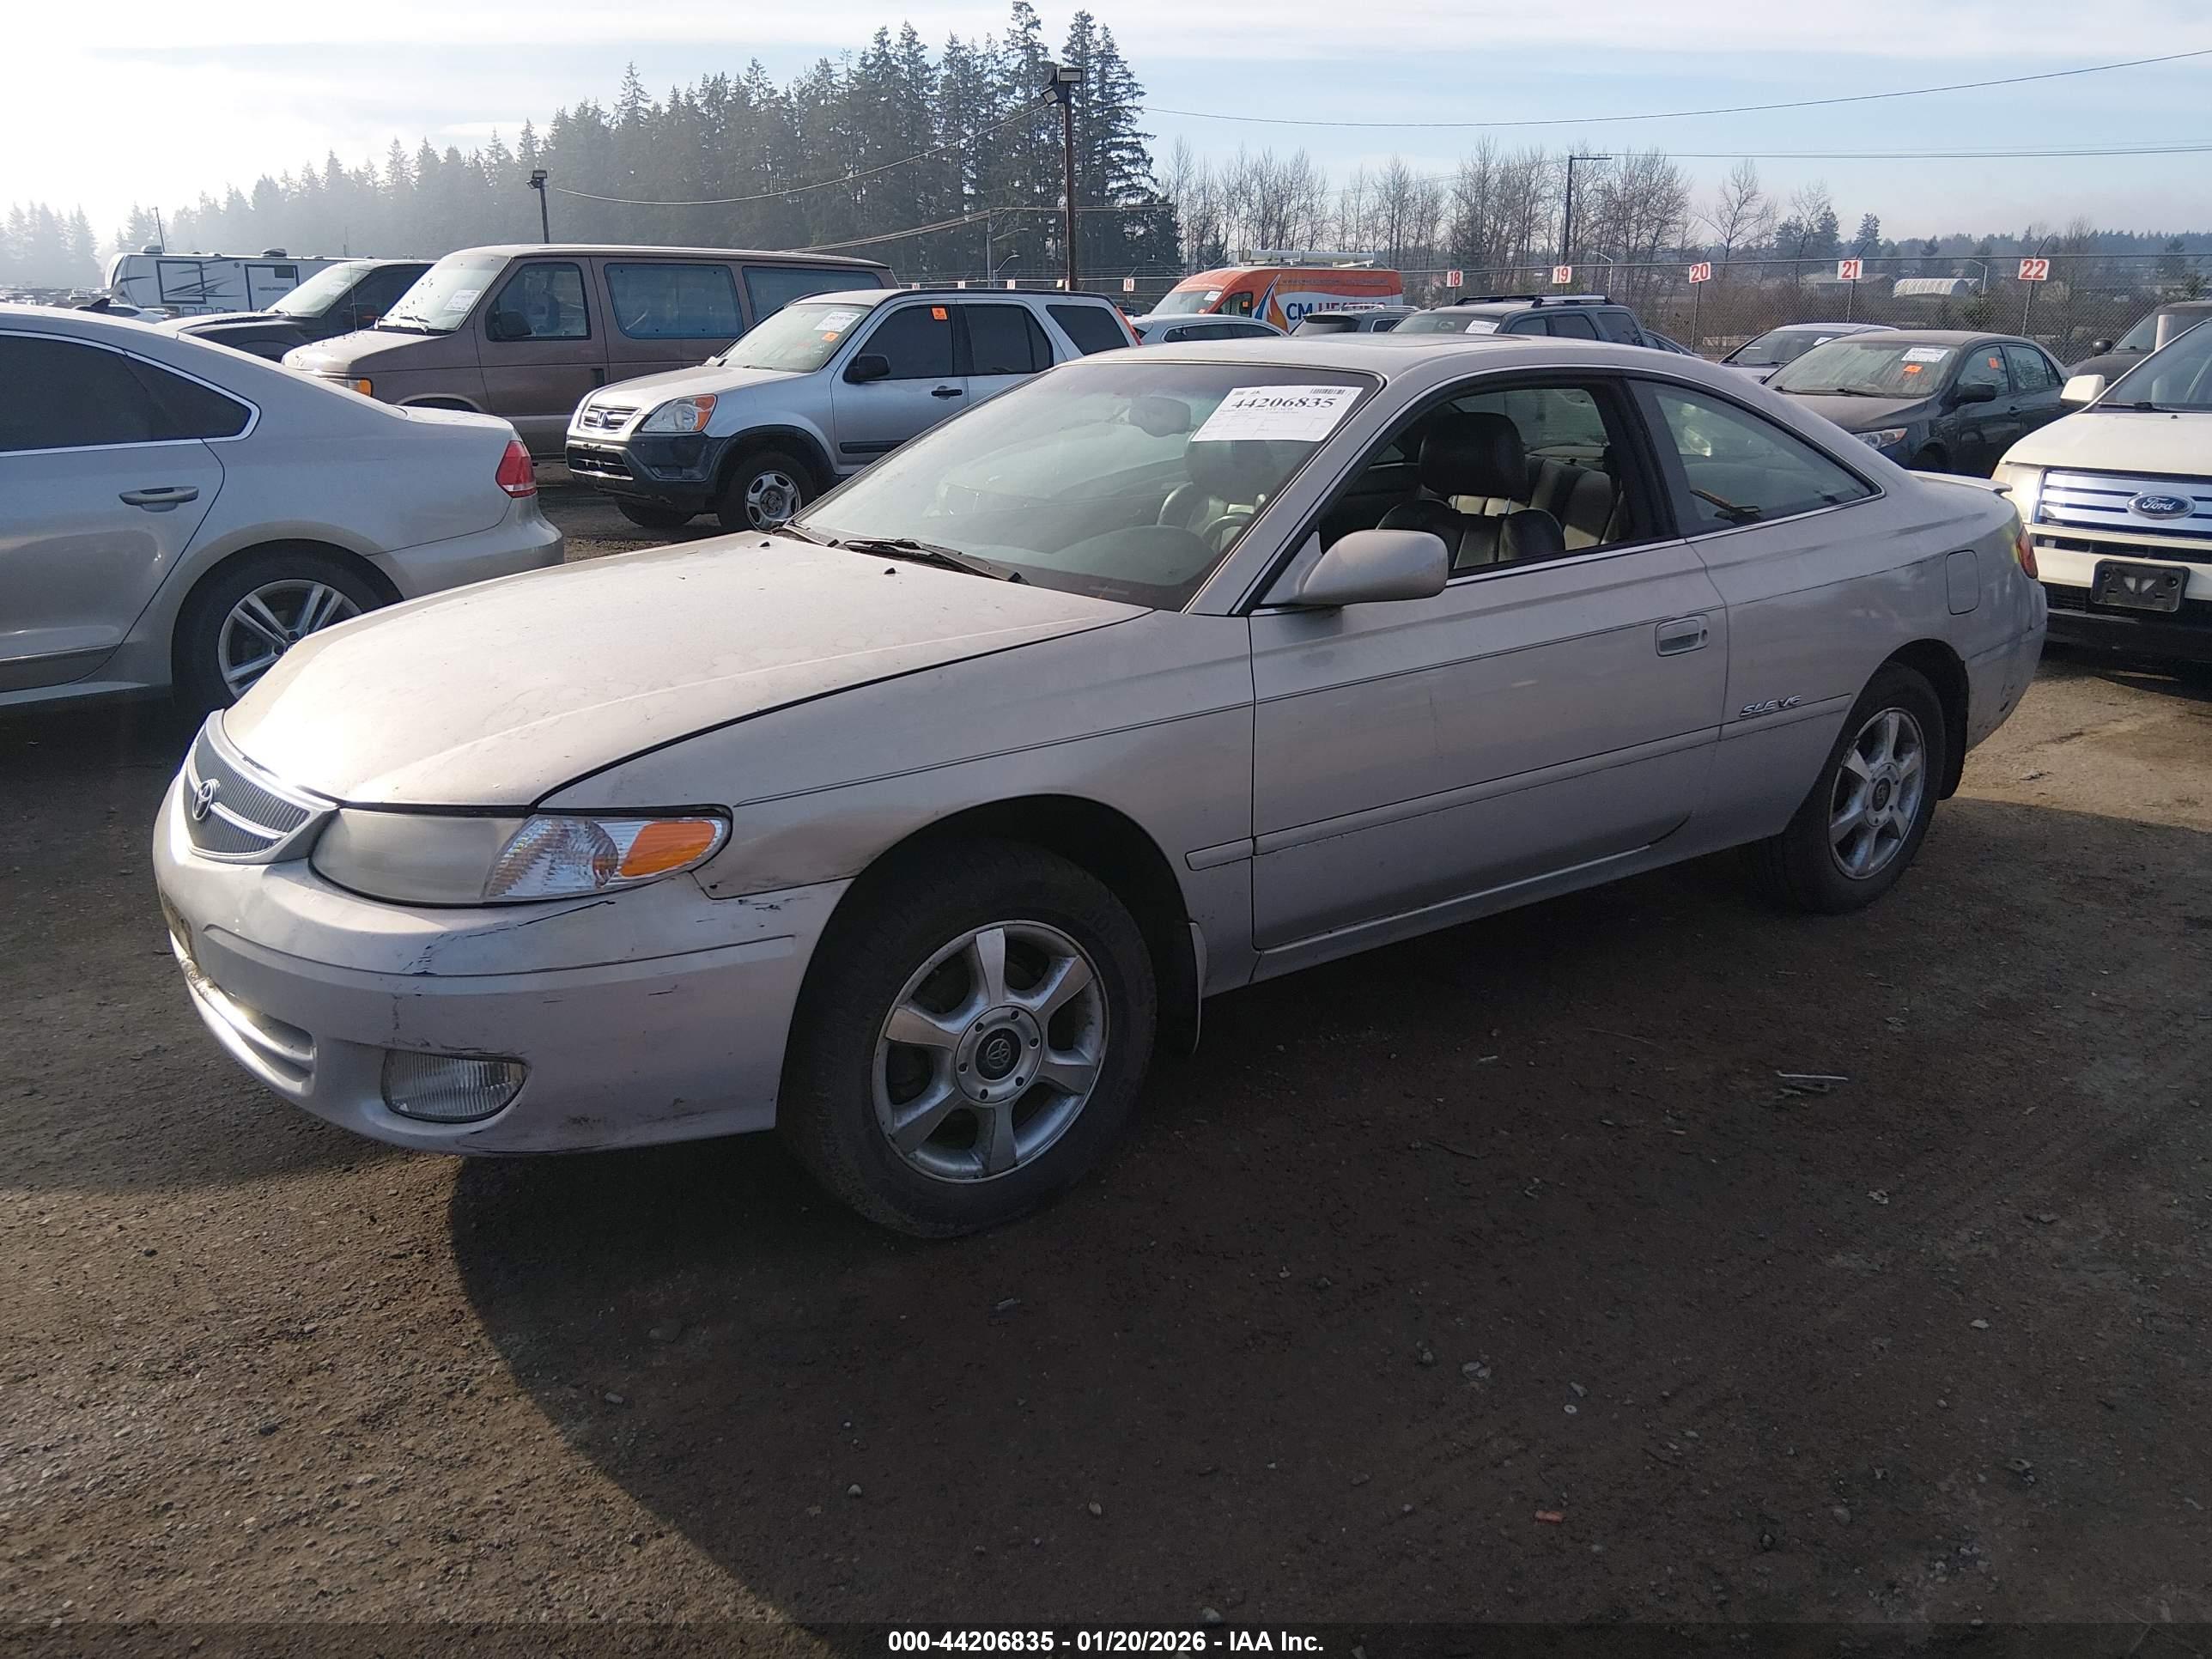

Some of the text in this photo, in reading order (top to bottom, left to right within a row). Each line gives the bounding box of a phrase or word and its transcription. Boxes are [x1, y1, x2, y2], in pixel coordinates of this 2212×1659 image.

[1555, 267, 1569, 283] 19
[1690, 264, 1709, 282] 20
[1842, 261, 1858, 278] 21
[2021, 260, 2046, 279] 22
[1450, 271, 1461, 286] 18
[1286, 303, 1313, 320] CM
[1231, 397, 1337, 409] 44206835
[2142, 496, 2176, 510] Ford
[1740, 700, 1778, 716] SLE
